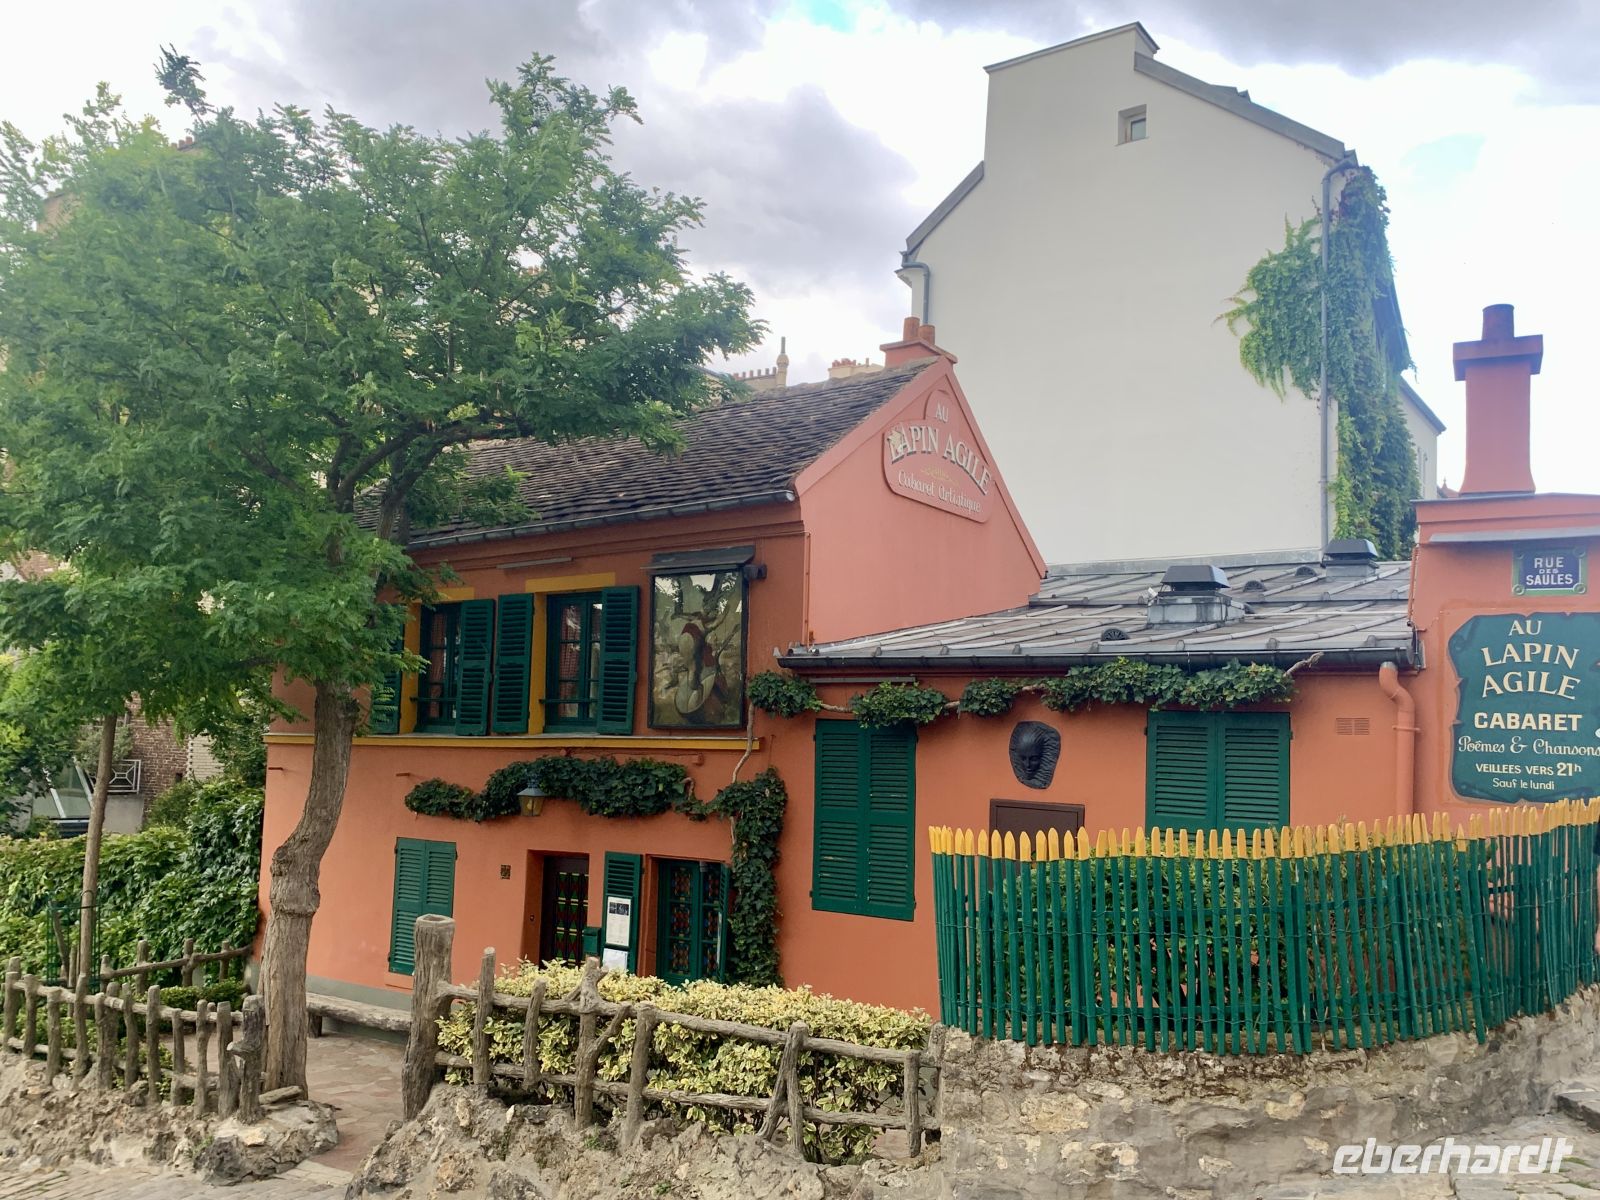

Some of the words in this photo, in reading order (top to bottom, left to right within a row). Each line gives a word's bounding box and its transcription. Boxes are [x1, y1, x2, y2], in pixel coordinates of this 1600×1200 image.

[935, 402, 949, 423] AU
[886, 422, 940, 464] LAPIN
[942, 432, 992, 496] AGILE
[898, 470, 935, 497] Cabaret
[1534, 557, 1564, 569] RUE
[1526, 574, 1573, 586] SAULES
[1508, 619, 1542, 636] AU
[1480, 642, 1580, 670] LAPIN
[1481, 670, 1581, 700] AGILE
[1474, 712, 1582, 731] CABARET
[1509, 736, 1528, 753] &
[1533, 738, 1600, 757] Chansons
[1475, 763, 1521, 774] VEILLEES
[1525, 765, 1554, 776] VERS
[1492, 777, 1517, 788] Sauf
[1520, 779, 1528, 789] le
[1530, 779, 1555, 790] lundi
